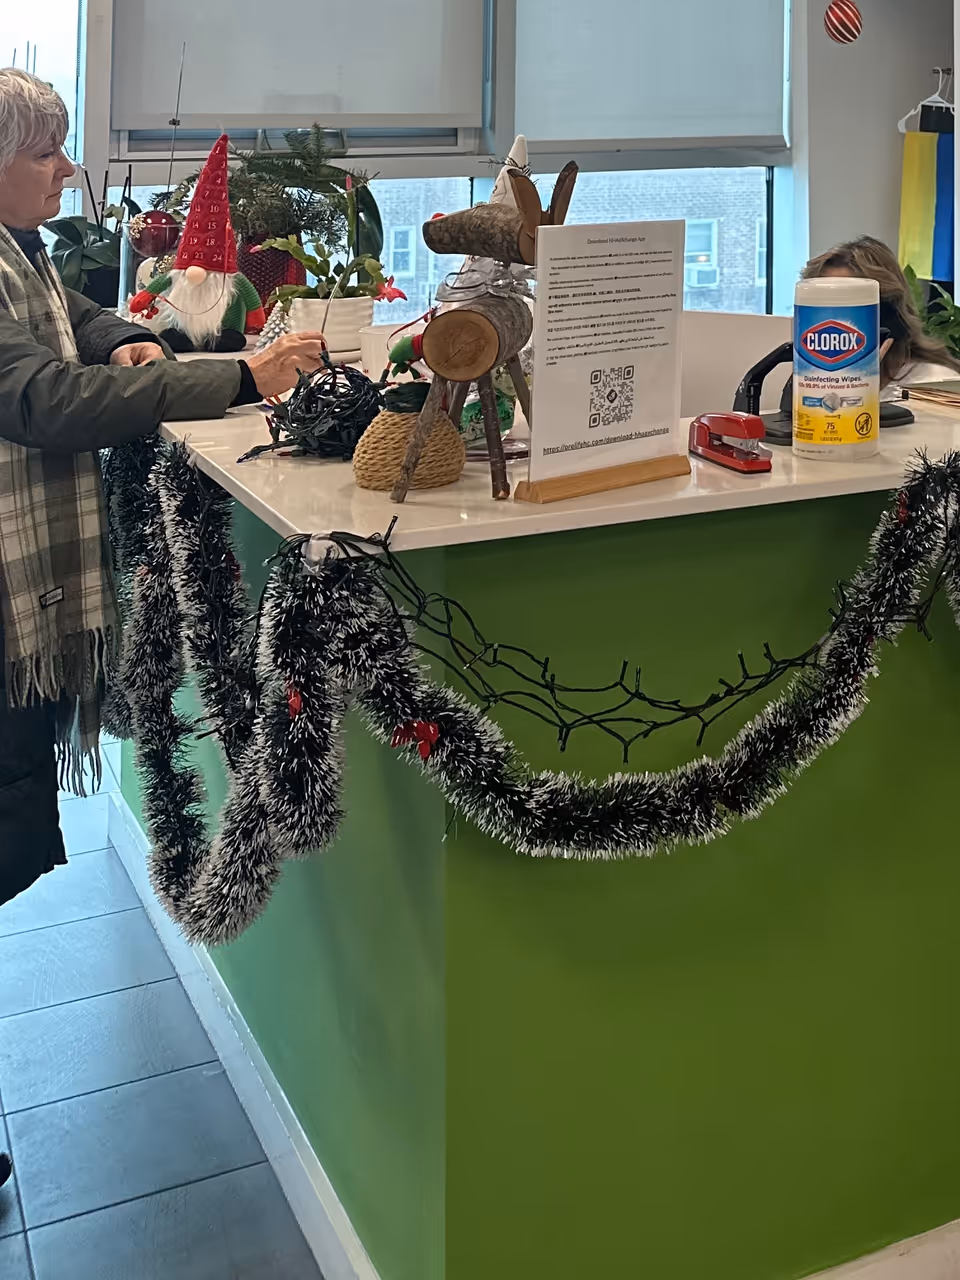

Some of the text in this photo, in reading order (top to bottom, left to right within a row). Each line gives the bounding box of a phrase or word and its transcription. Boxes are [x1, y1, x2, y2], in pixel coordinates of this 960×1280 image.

[209, 204, 220, 213] 10
[207, 221, 217, 230] 15
[806, 332, 858, 351] CLOROX
[804, 375, 839, 384] Disinfecting
[826, 422, 835, 430] 75
